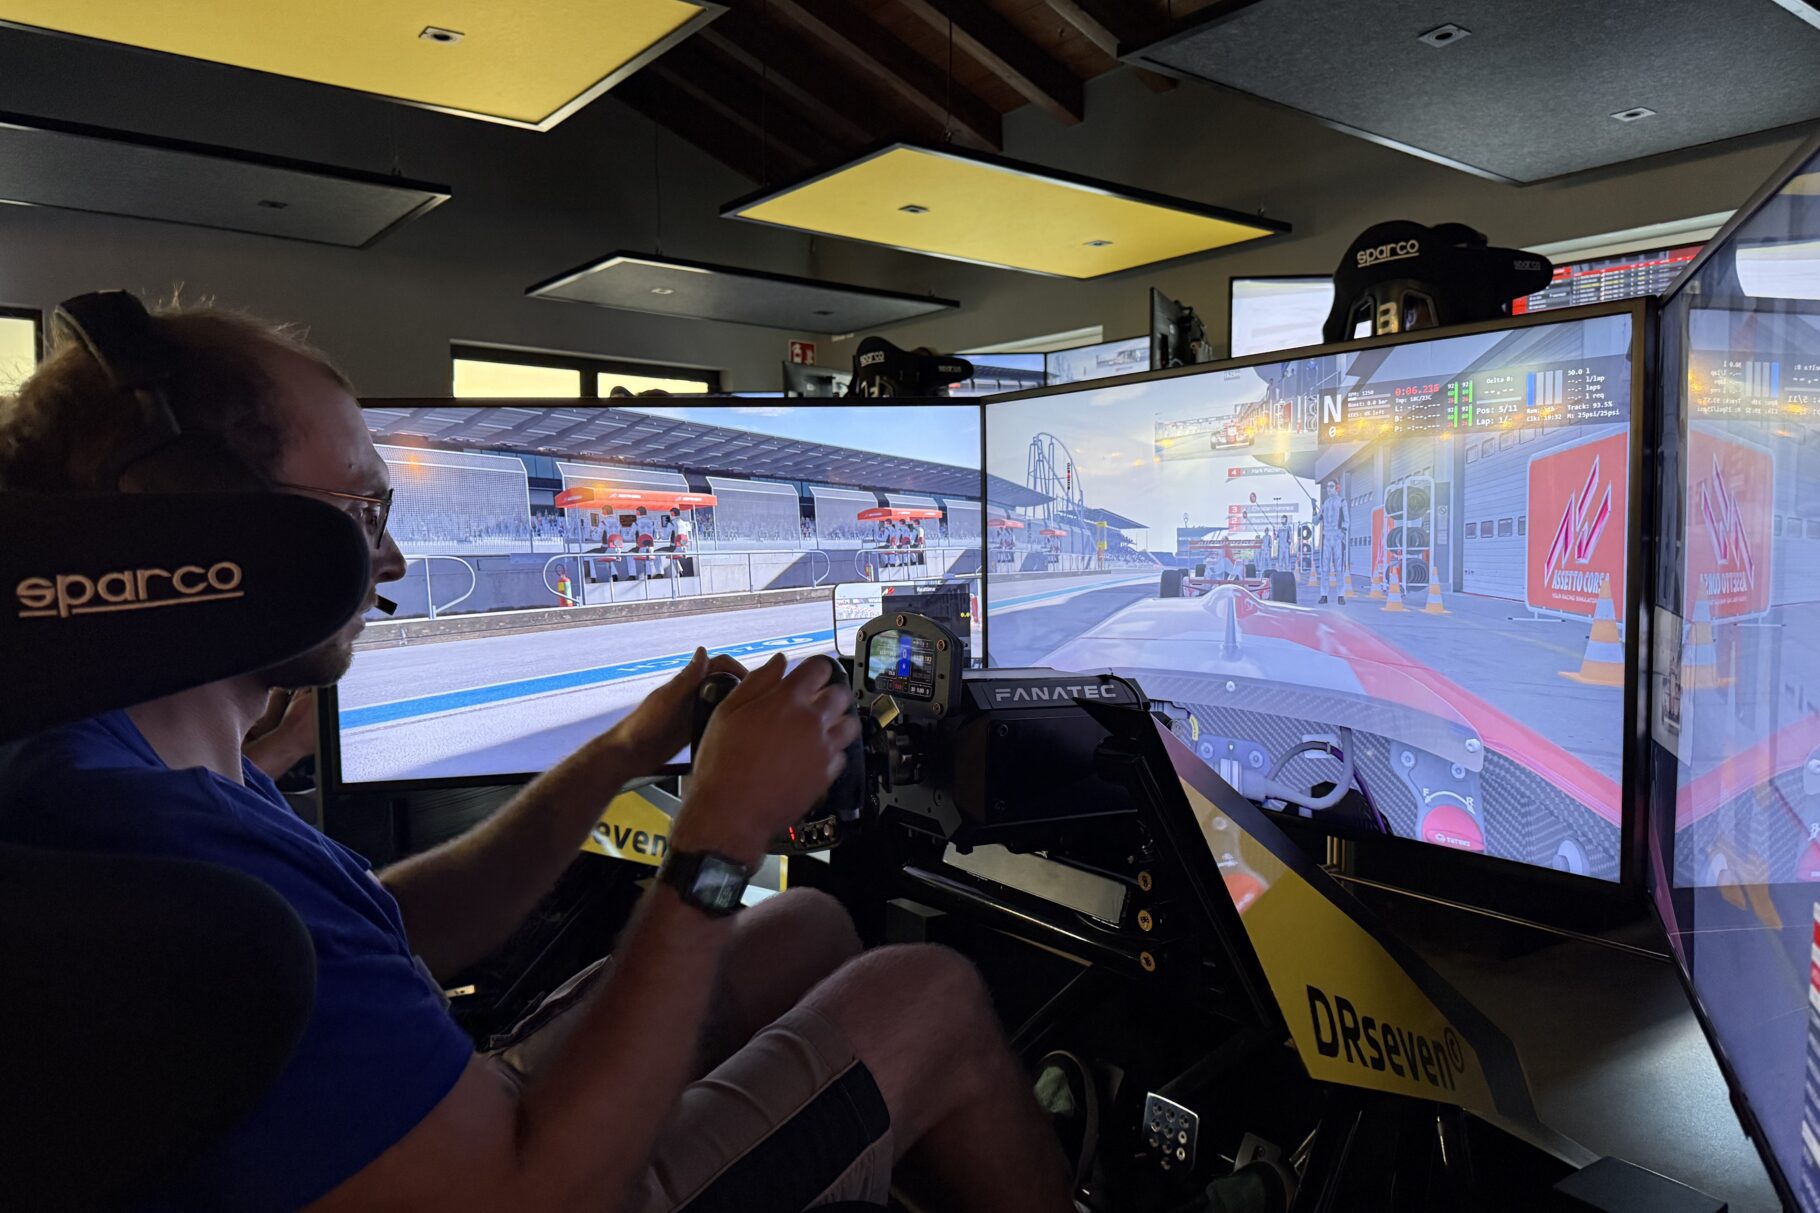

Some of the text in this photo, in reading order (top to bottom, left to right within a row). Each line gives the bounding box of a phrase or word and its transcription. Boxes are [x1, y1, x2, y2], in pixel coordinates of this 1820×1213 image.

[1357, 239, 1419, 266] sparco
[860, 351, 885, 367] sparco
[1323, 394, 1342, 424] N
[1476, 404, 1518, 415] Pos: 5/11
[1476, 418, 1494, 426] Lap:
[1328, 426, 1337, 438] 0
[1231, 468, 1238, 476] 4
[1231, 505, 1238, 513] 3
[1552, 570, 1583, 592] ASSETTO
[16, 561, 244, 618] sparco
[995, 684, 1117, 702] FANATEC
[1423, 787, 1430, 796] F
[1466, 796, 1474, 806] R
